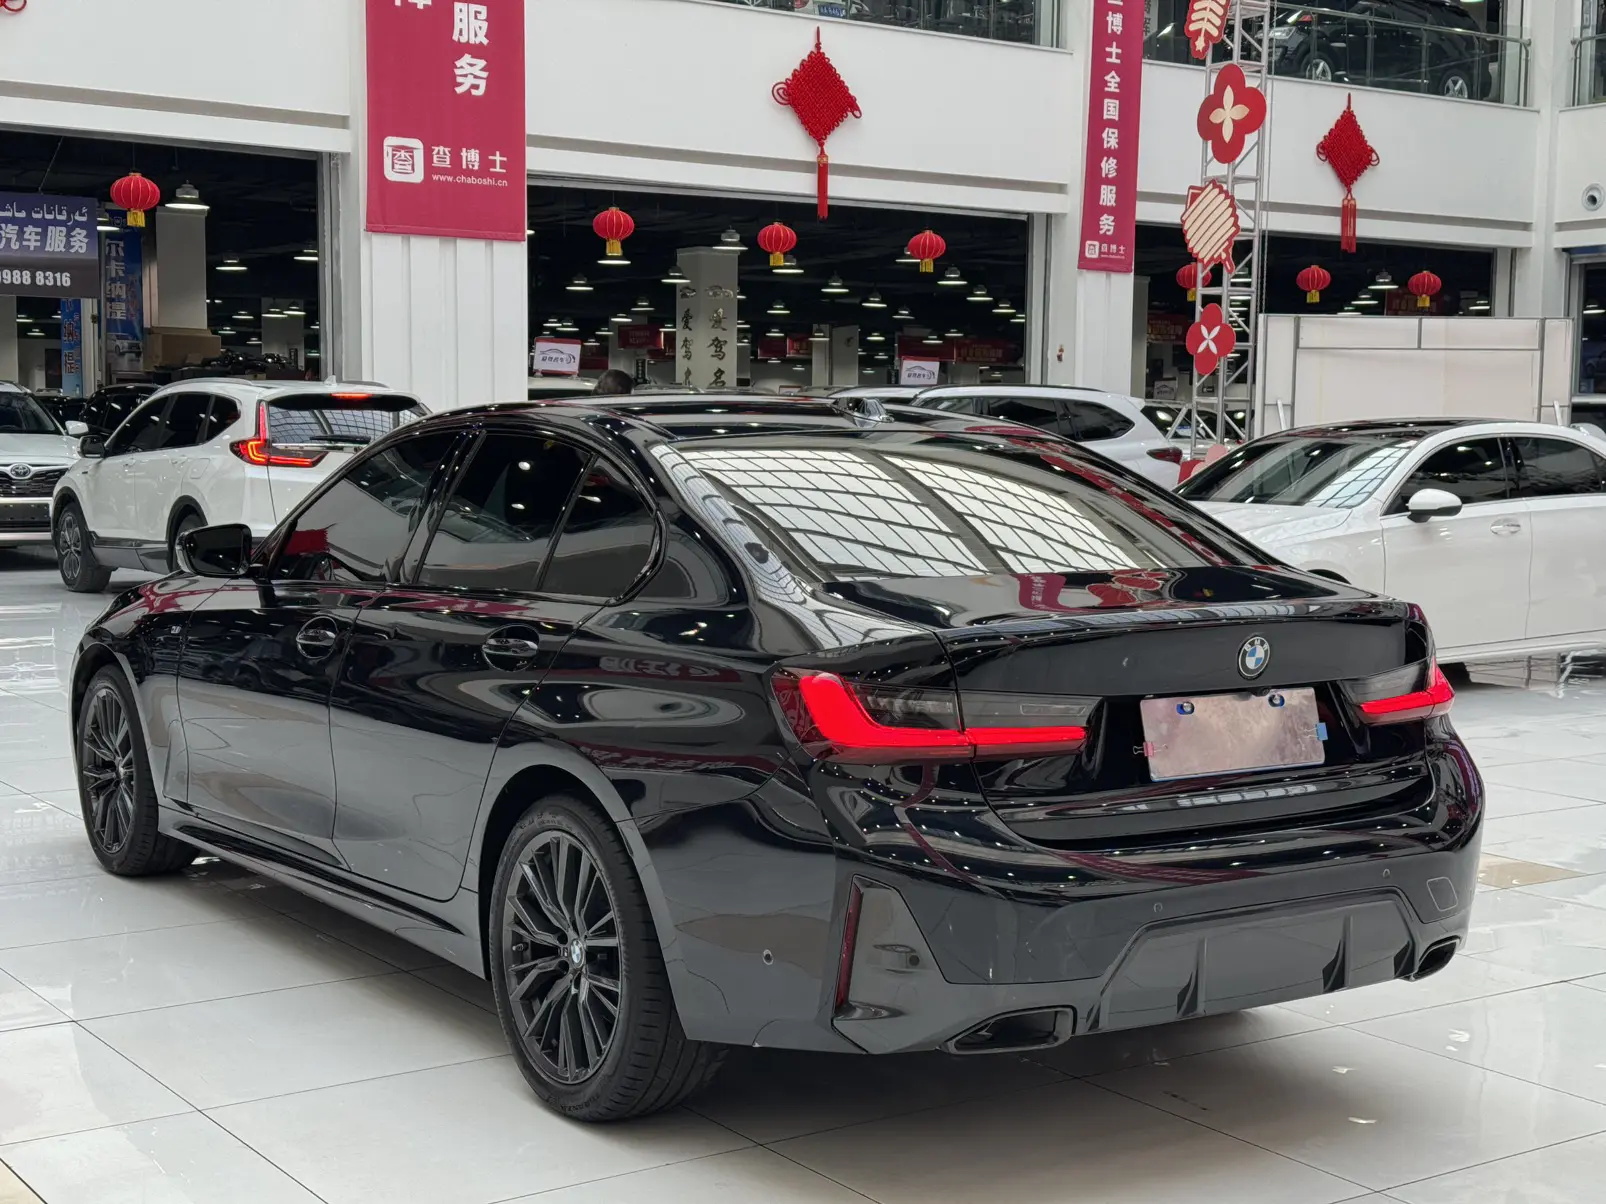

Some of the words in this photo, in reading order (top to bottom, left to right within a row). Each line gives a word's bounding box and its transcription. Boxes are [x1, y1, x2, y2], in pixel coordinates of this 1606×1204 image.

[452, 2, 489, 96] 服务
[1098, 0, 1123, 235] 博士全国保修服务
[431, 145, 508, 173] 查博士
[432, 173, 508, 187] www.chaboshi.cn
[0, 223, 90, 253] 汽车服务
[0, 269, 31, 285] 988
[35, 270, 71, 287] 8316
[1244, 639, 1268, 651] BMW
